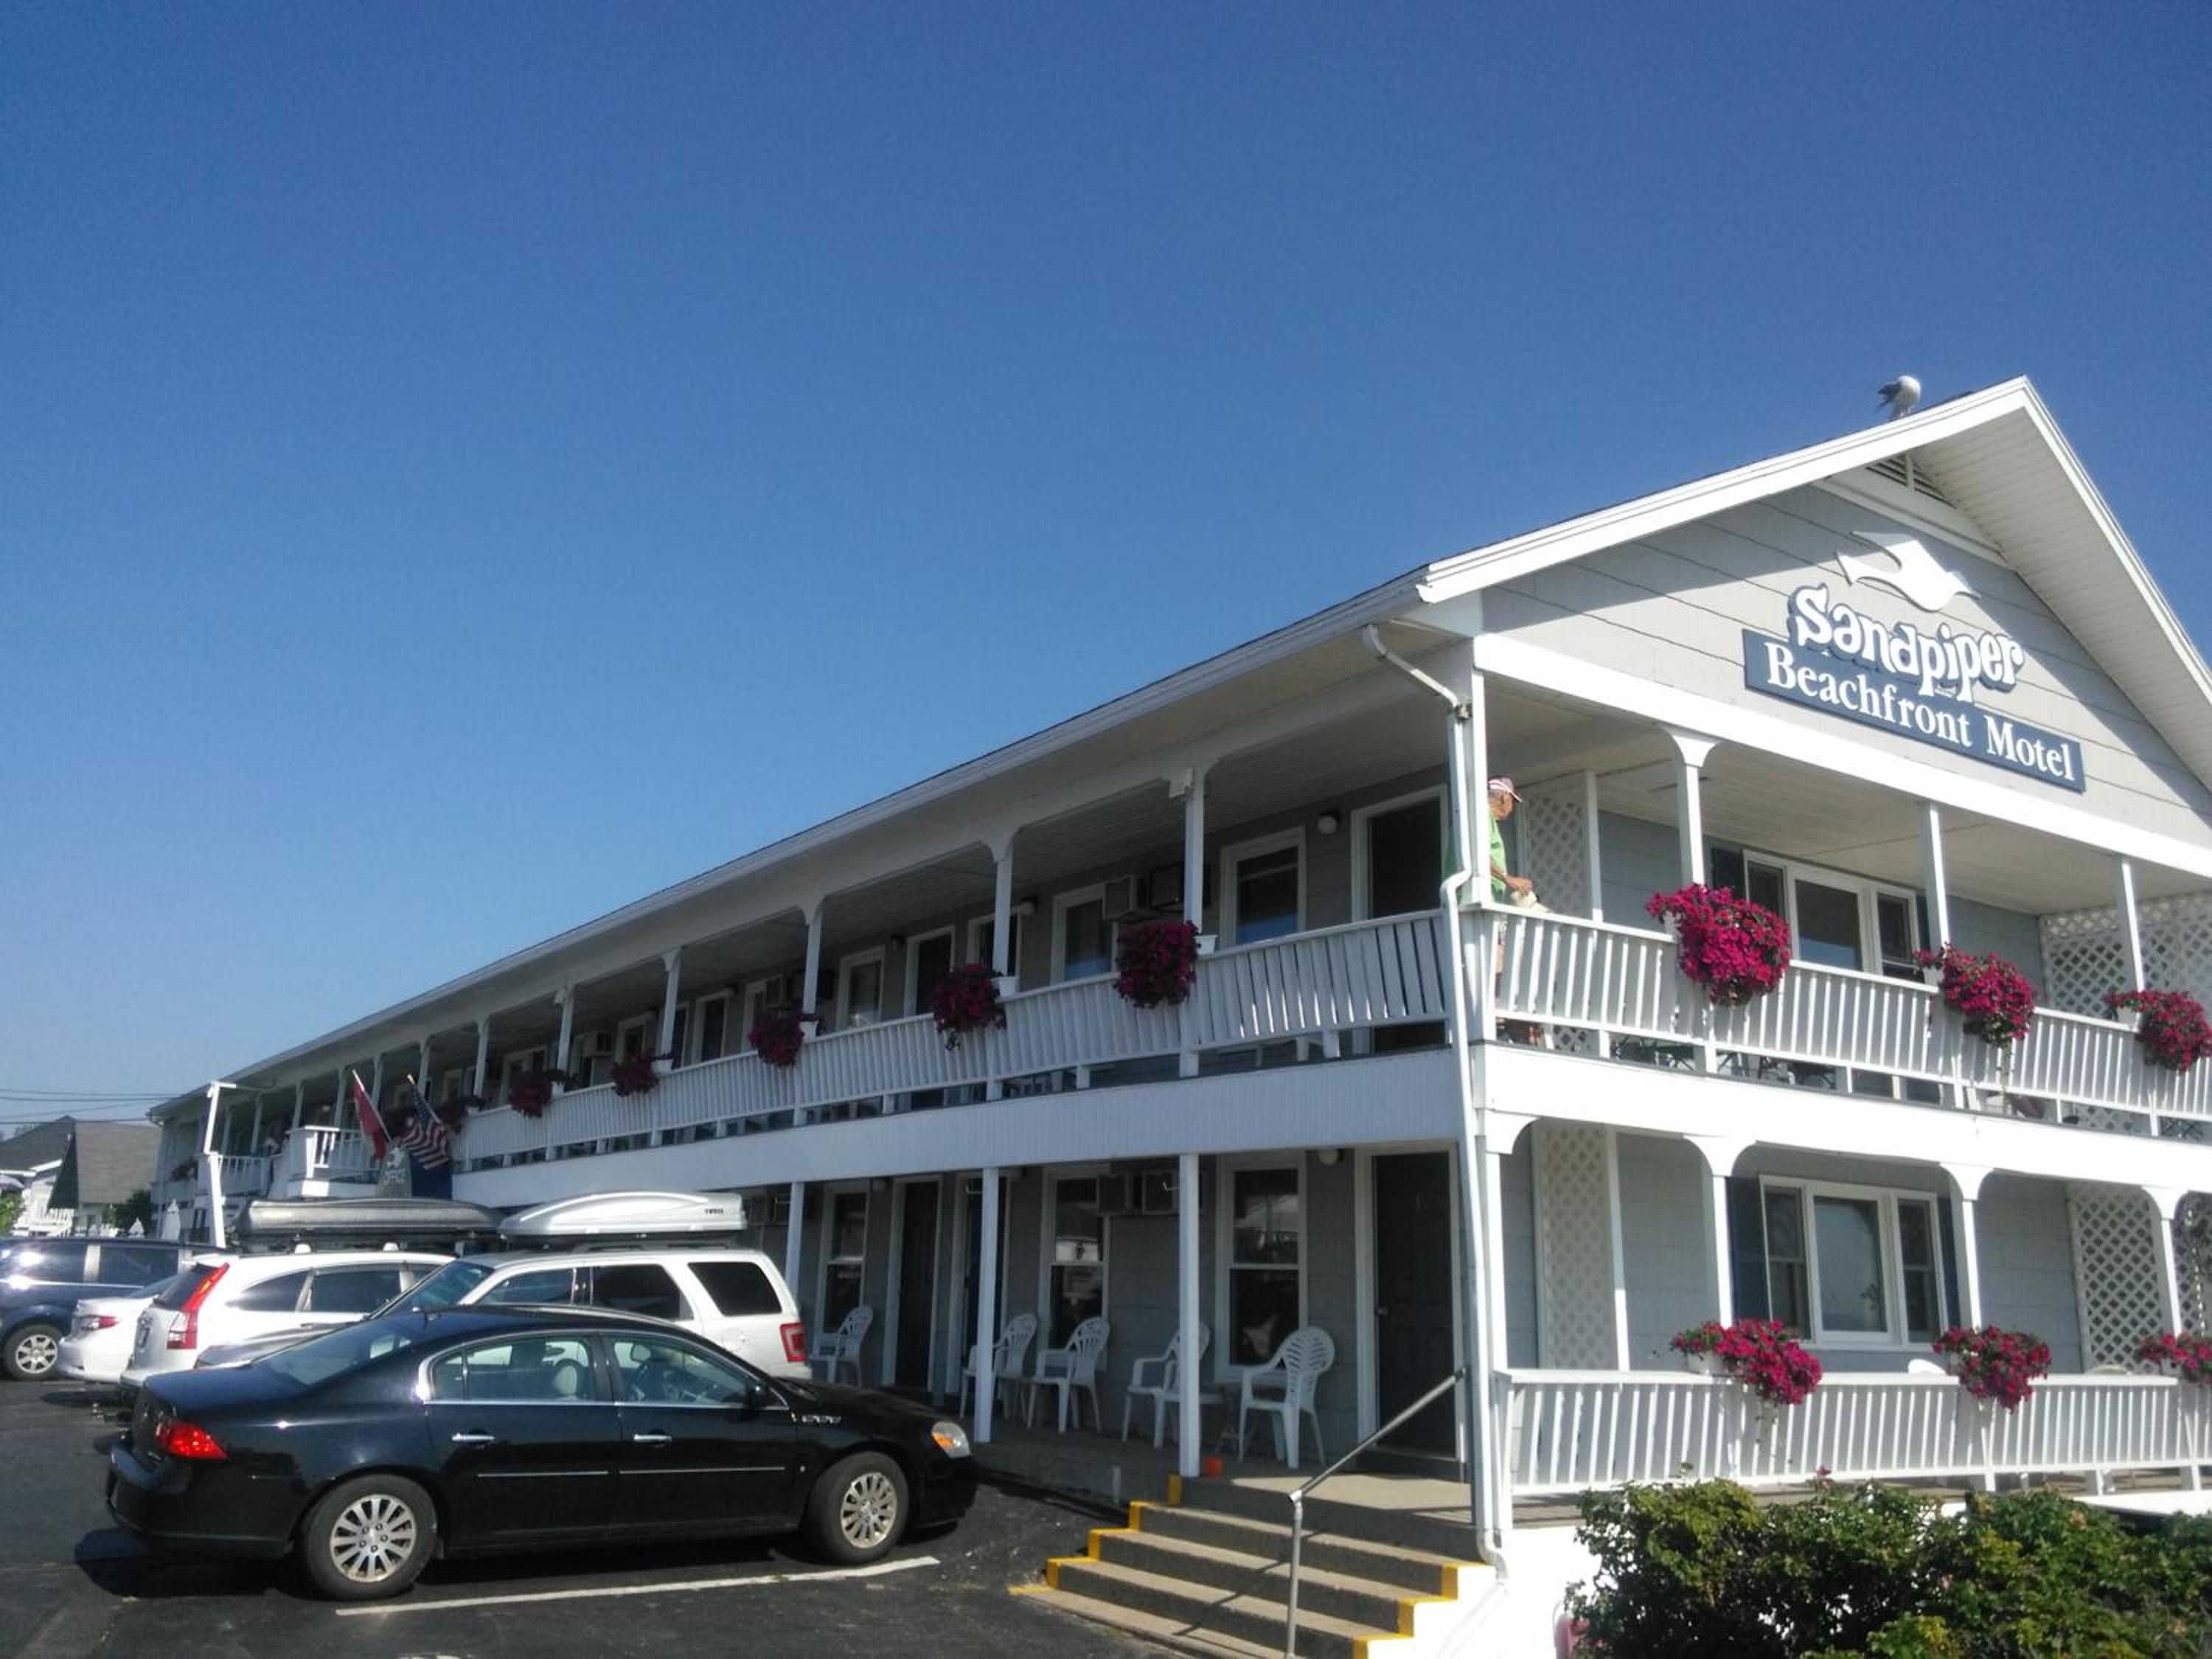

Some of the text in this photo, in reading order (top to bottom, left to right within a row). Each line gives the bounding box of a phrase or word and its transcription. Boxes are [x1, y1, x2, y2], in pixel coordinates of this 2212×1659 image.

[1794, 584, 2024, 703] Sandpiper
[1764, 642, 2075, 782] Beachfront Motel
